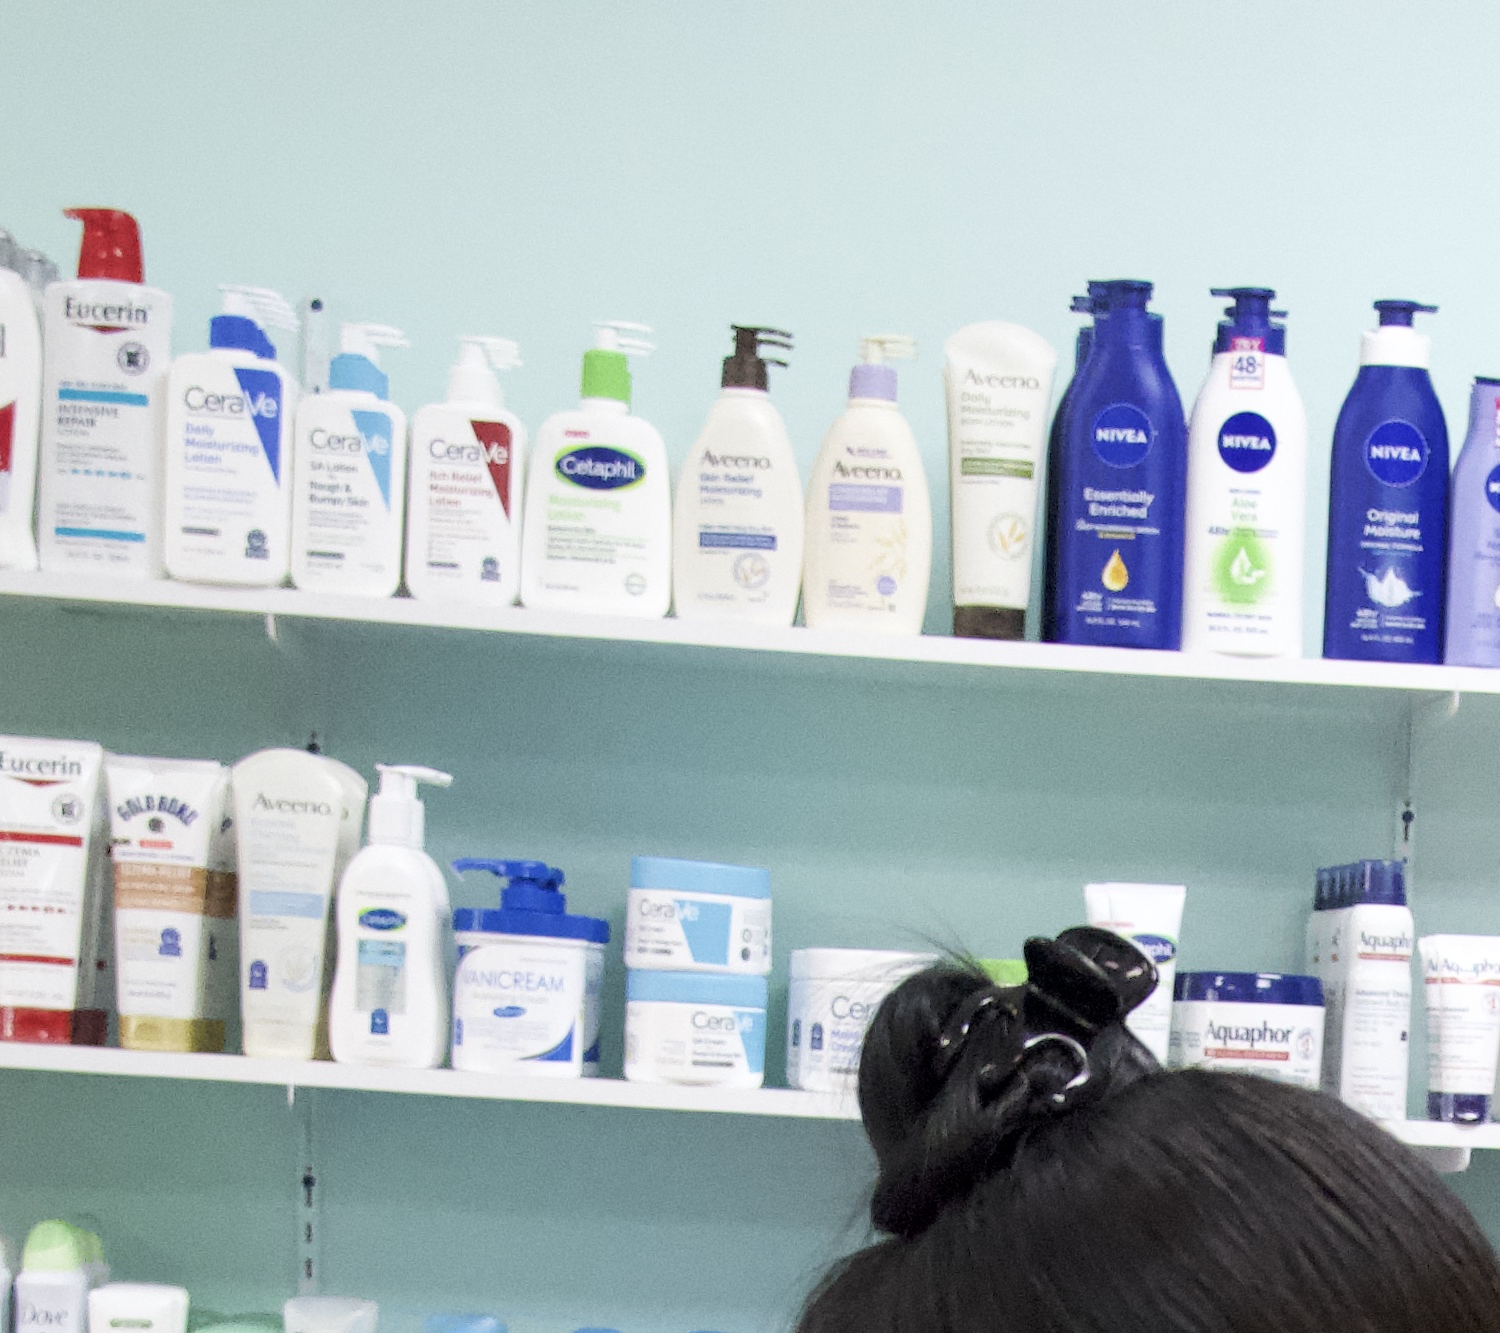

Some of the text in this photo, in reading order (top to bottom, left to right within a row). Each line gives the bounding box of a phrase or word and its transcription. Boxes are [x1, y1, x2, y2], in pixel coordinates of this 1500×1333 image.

[63, 297, 150, 325] Eucerin
[964, 369, 1041, 391] Aveeno
[184, 386, 279, 419] CeraVe
[310, 428, 389, 457] CeraVe
[1096, 428, 1147, 444] NIVEA
[1223, 435, 1271, 452] NIVEA
[429, 438, 508, 465] CeraVe
[700, 450, 772, 470] Aveeno
[1371, 445, 1421, 463] NIVEA
[560, 456, 637, 481] Cetaphil
[831, 461, 901, 481] Aveeno
[1083, 487, 1154, 505] Essentially
[1088, 503, 1148, 519] Enriched
[1367, 509, 1419, 528] Original
[1364, 524, 1421, 541] Moisture
[252, 793, 332, 816] Aveeno
[639, 898, 698, 922] CeraVe
[1360, 931, 1413, 955] Aquaph
[691, 1011, 752, 1032] CeraVe
[1206, 1020, 1294, 1046] Aquaphor
[21, 1303, 69, 1326] Dove
